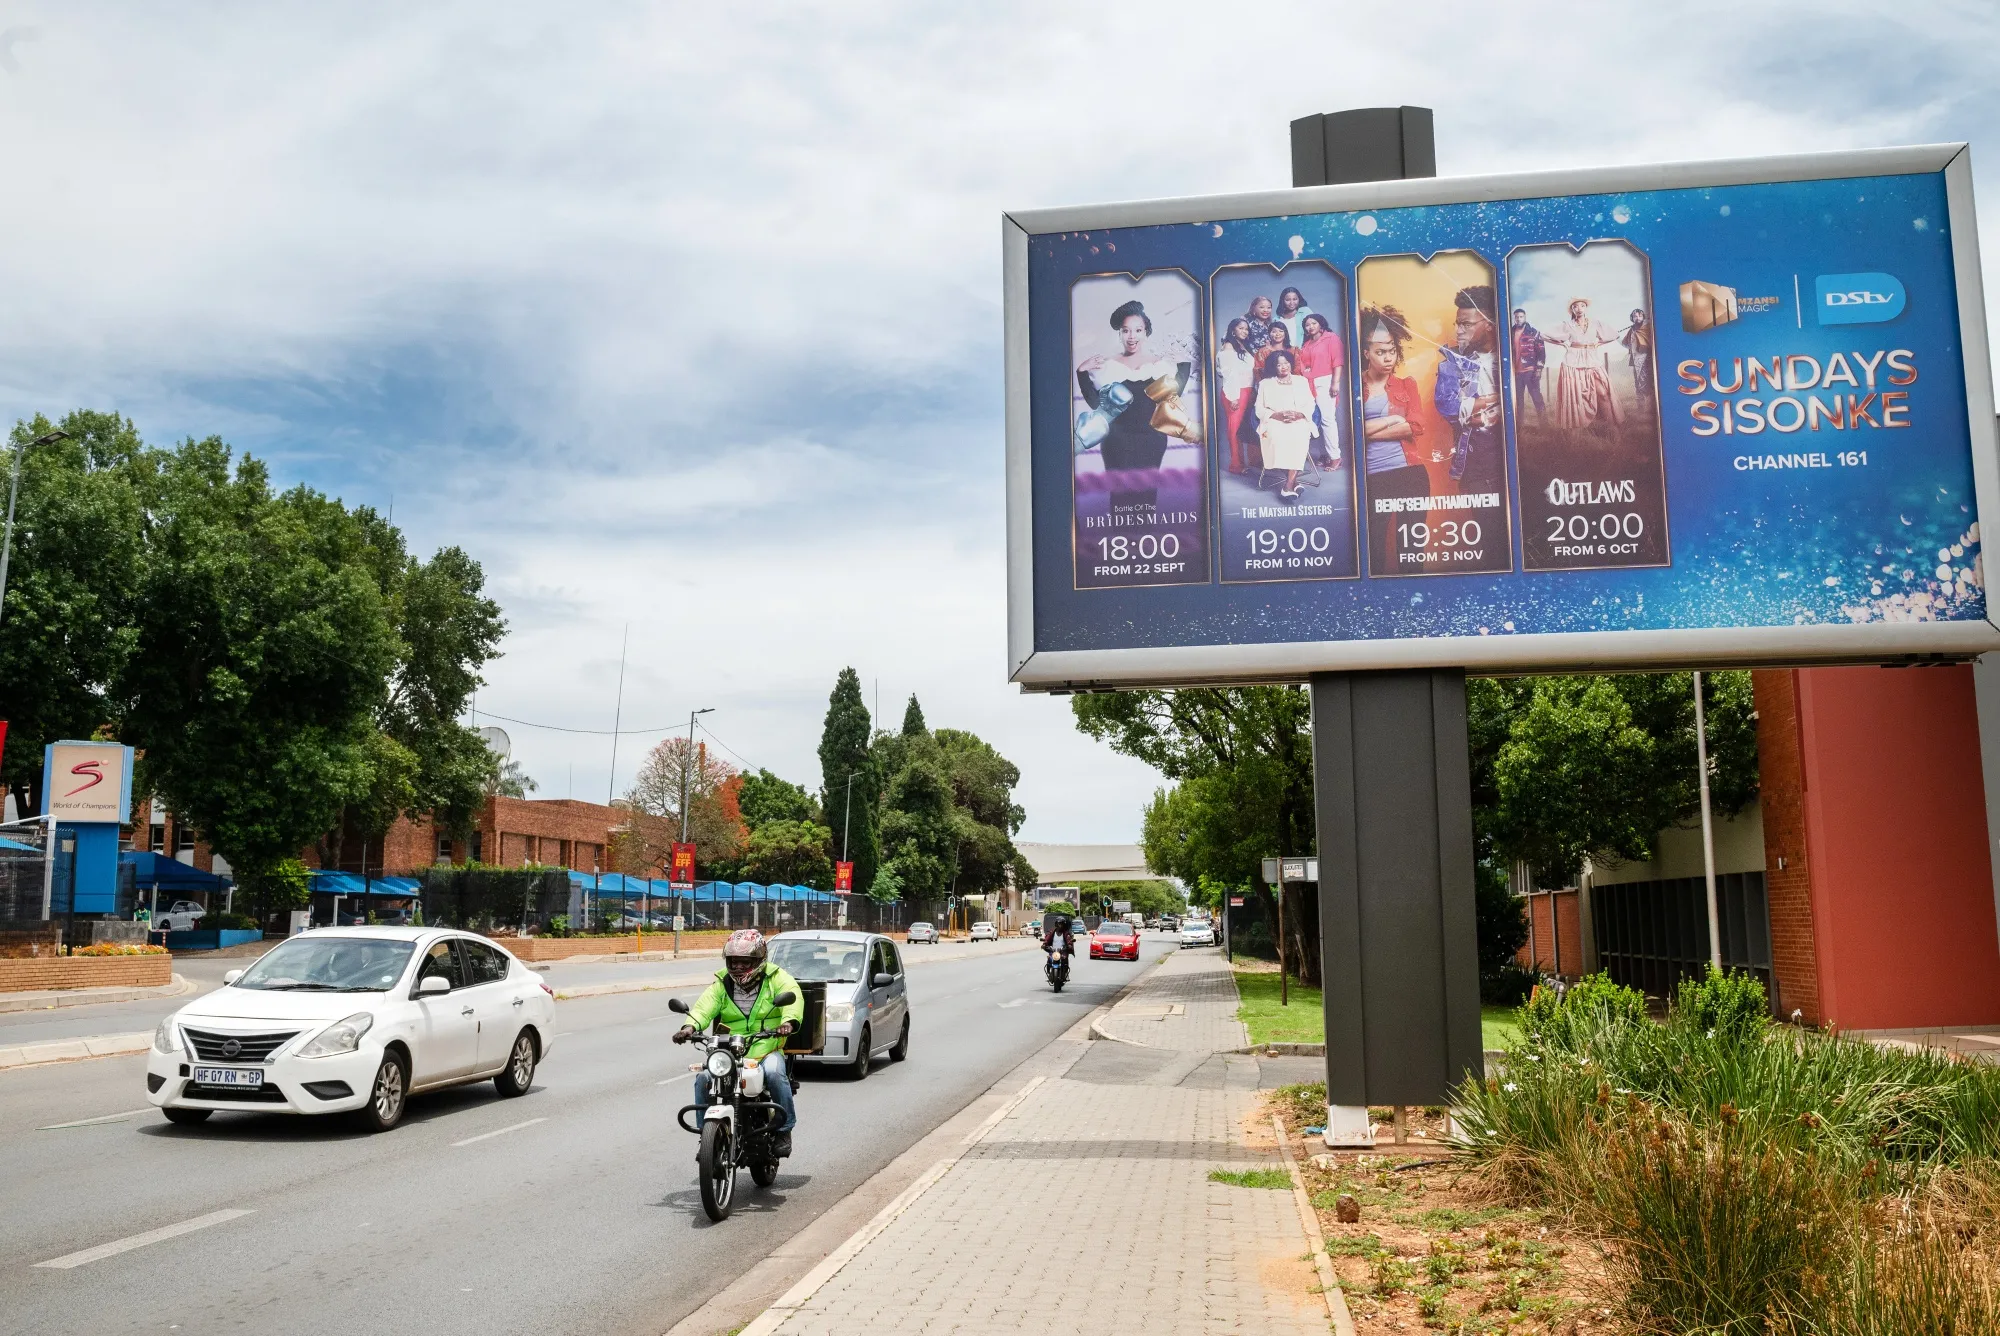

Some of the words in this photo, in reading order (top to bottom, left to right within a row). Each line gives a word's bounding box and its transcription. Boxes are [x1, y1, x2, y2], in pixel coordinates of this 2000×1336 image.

[1737, 296, 1779, 305] MZANSI
[1826, 291, 1894, 306] DStv
[1738, 303, 1770, 313] MAGIC
[1677, 349, 1918, 395] SUNDAYS
[1690, 391, 1911, 436] SISONKE
[1733, 452, 1832, 471] CHANNEL
[1836, 451, 1868, 466] 161
[1114, 505, 1133, 513] Battle
[1144, 503, 1156, 511] The
[1086, 511, 1198, 528] BRIDESMAIDS
[1546, 512, 1644, 541] 20:00
[1245, 527, 1330, 554] 19:00
[1397, 520, 1482, 548] 19:30
[1097, 533, 1180, 561] 18:00
[1554, 545, 1594, 556] FROM
[1597, 544, 1606, 555] 6
[1610, 543, 1639, 554] OCT
[1245, 558, 1283, 570] FROM
[1286, 557, 1301, 567] 10
[1304, 556, 1333, 567] NOV
[1399, 552, 1438, 563] FROM
[1441, 551, 1450, 562] 3
[1453, 550, 1484, 561] NOV
[1094, 564, 1131, 576] FROM
[1134, 564, 1150, 574] 22
[1153, 562, 1185, 573] SEPT
[81, 802, 117, 810] Champions
[675, 858, 691, 867] EFF
[197, 1069, 209, 1082] HF
[224, 1070, 237, 1083] RN
[248, 1071, 261, 1084] GP
